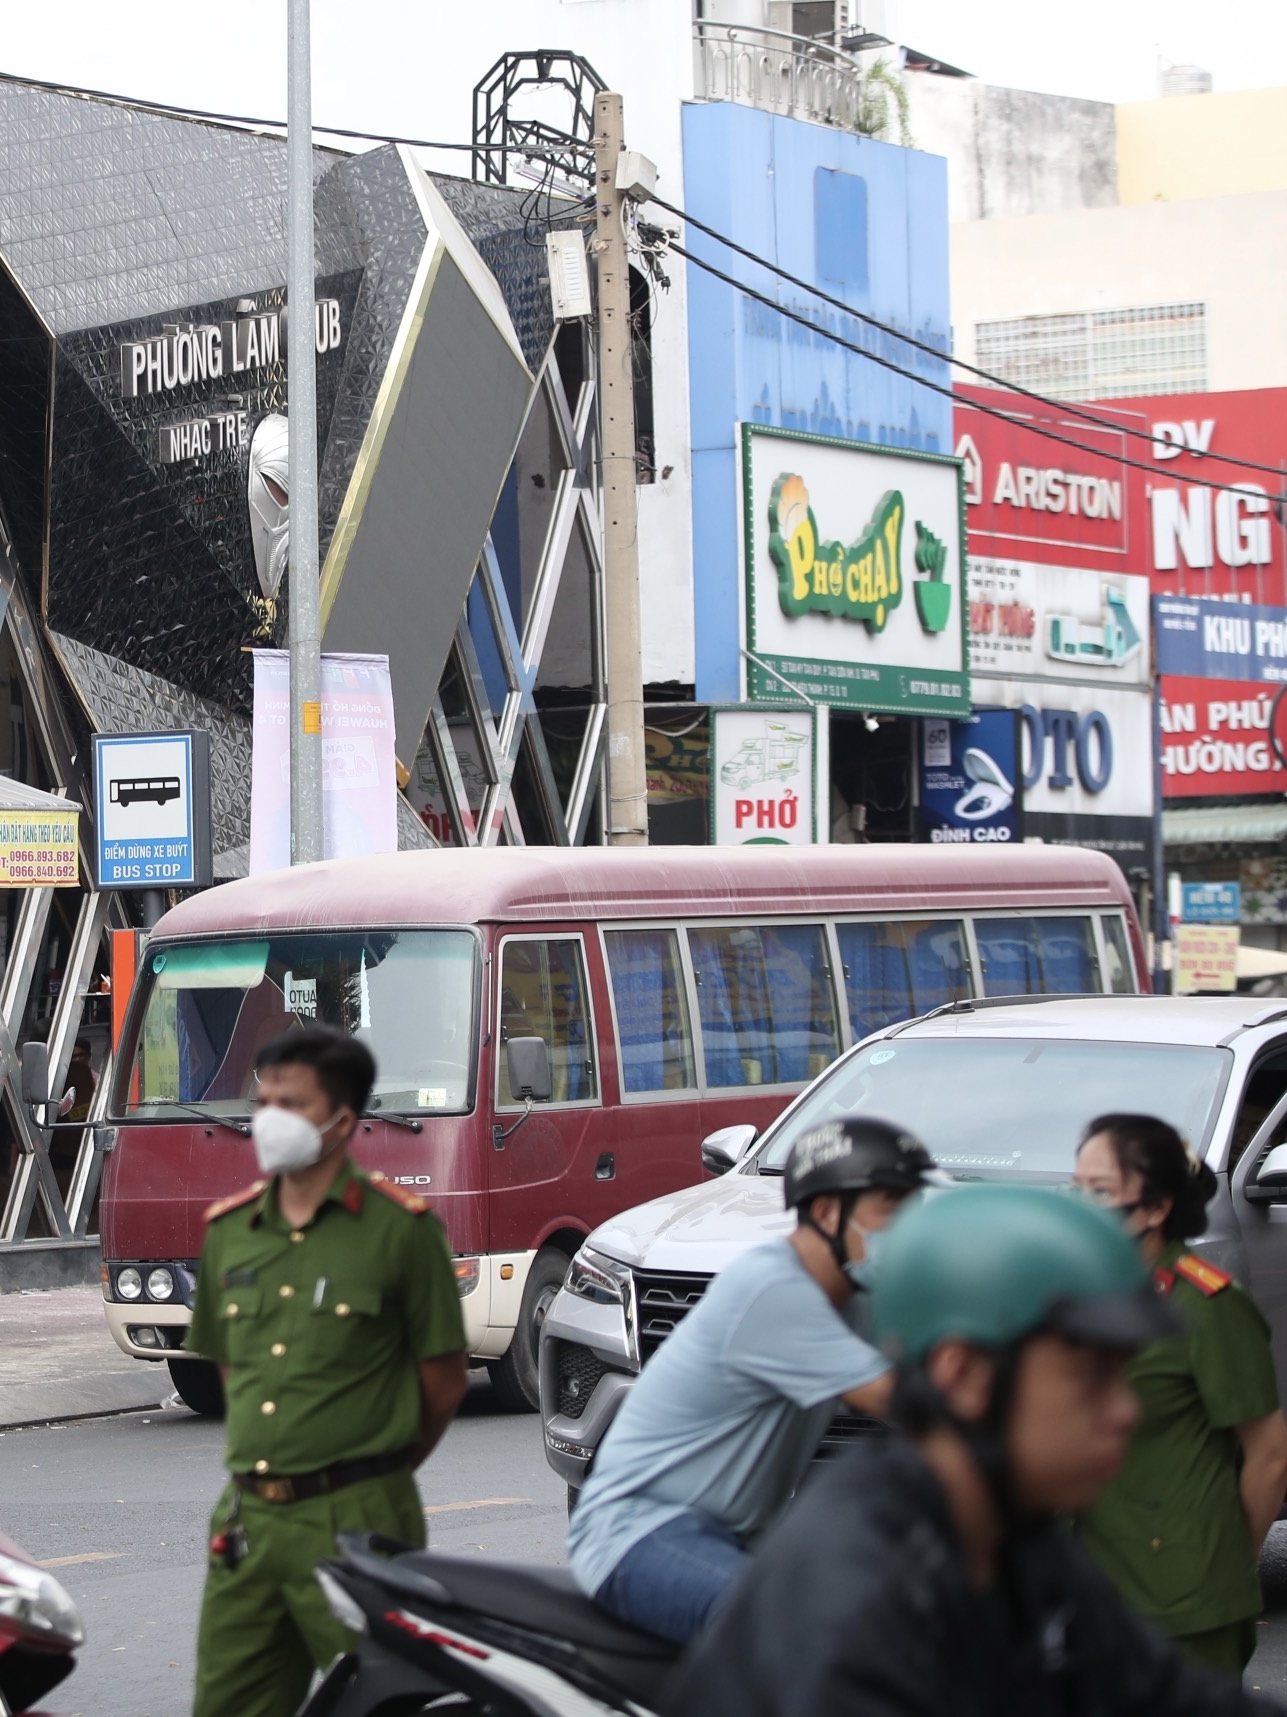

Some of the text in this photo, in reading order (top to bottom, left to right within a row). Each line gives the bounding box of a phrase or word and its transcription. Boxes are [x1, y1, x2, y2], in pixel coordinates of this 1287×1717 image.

[124, 323, 223, 397] PHƯƠNG
[226, 300, 280, 373] LÂM
[163, 394, 248, 467] NHẠC TRẺ
[993, 461, 1121, 521] ARISTON
[1146, 482, 1272, 570] NG
[1203, 615, 1251, 656] KHU
[1207, 692, 1273, 731] PHÚ
[734, 789, 799, 829] PHỞ
[38, 823, 51, 843] THEO
[104, 841, 188, 860] ĐIỂM DỪNG XE BUÝT
[930, 823, 1011, 843] ĐỈNH CAO
[9, 850, 75, 862] 0966.893.682
[9, 865, 75, 877] 0966.840.692
[113, 863, 181, 879] BUS STOP
